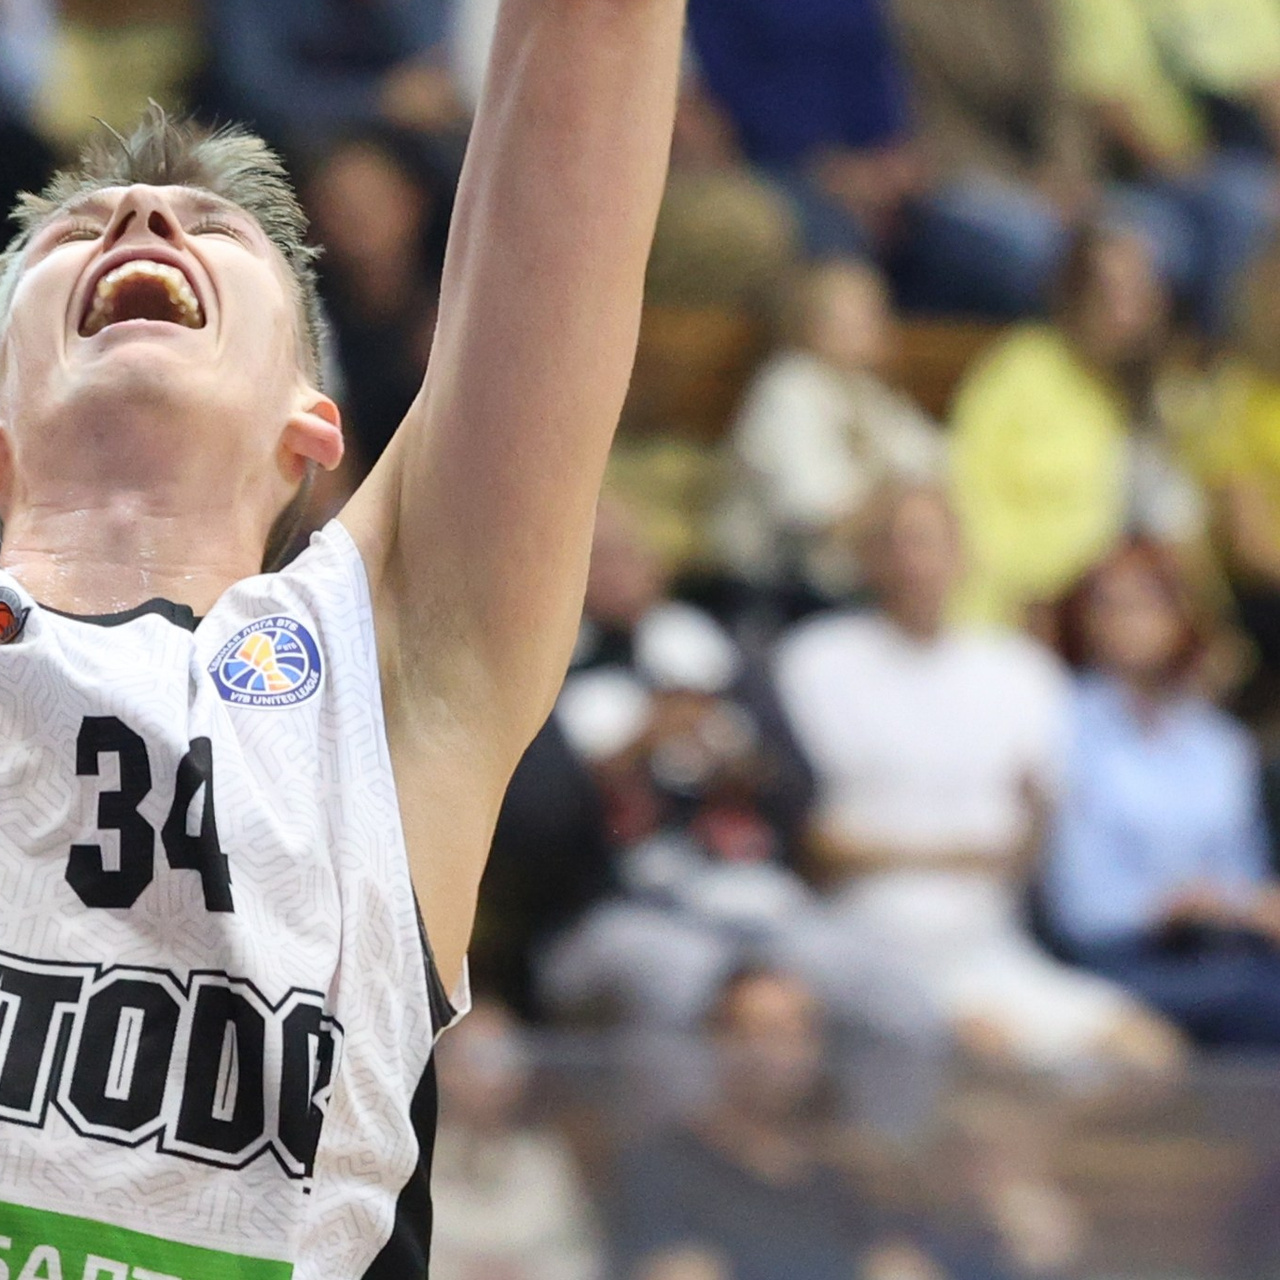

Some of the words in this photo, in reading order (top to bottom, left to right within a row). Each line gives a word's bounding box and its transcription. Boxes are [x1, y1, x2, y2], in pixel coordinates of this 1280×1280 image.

[243, 619, 274, 637] ЛИГА
[230, 692, 251, 703] VTB
[253, 694, 296, 705] UNITED
[65, 716, 234, 913] 34
